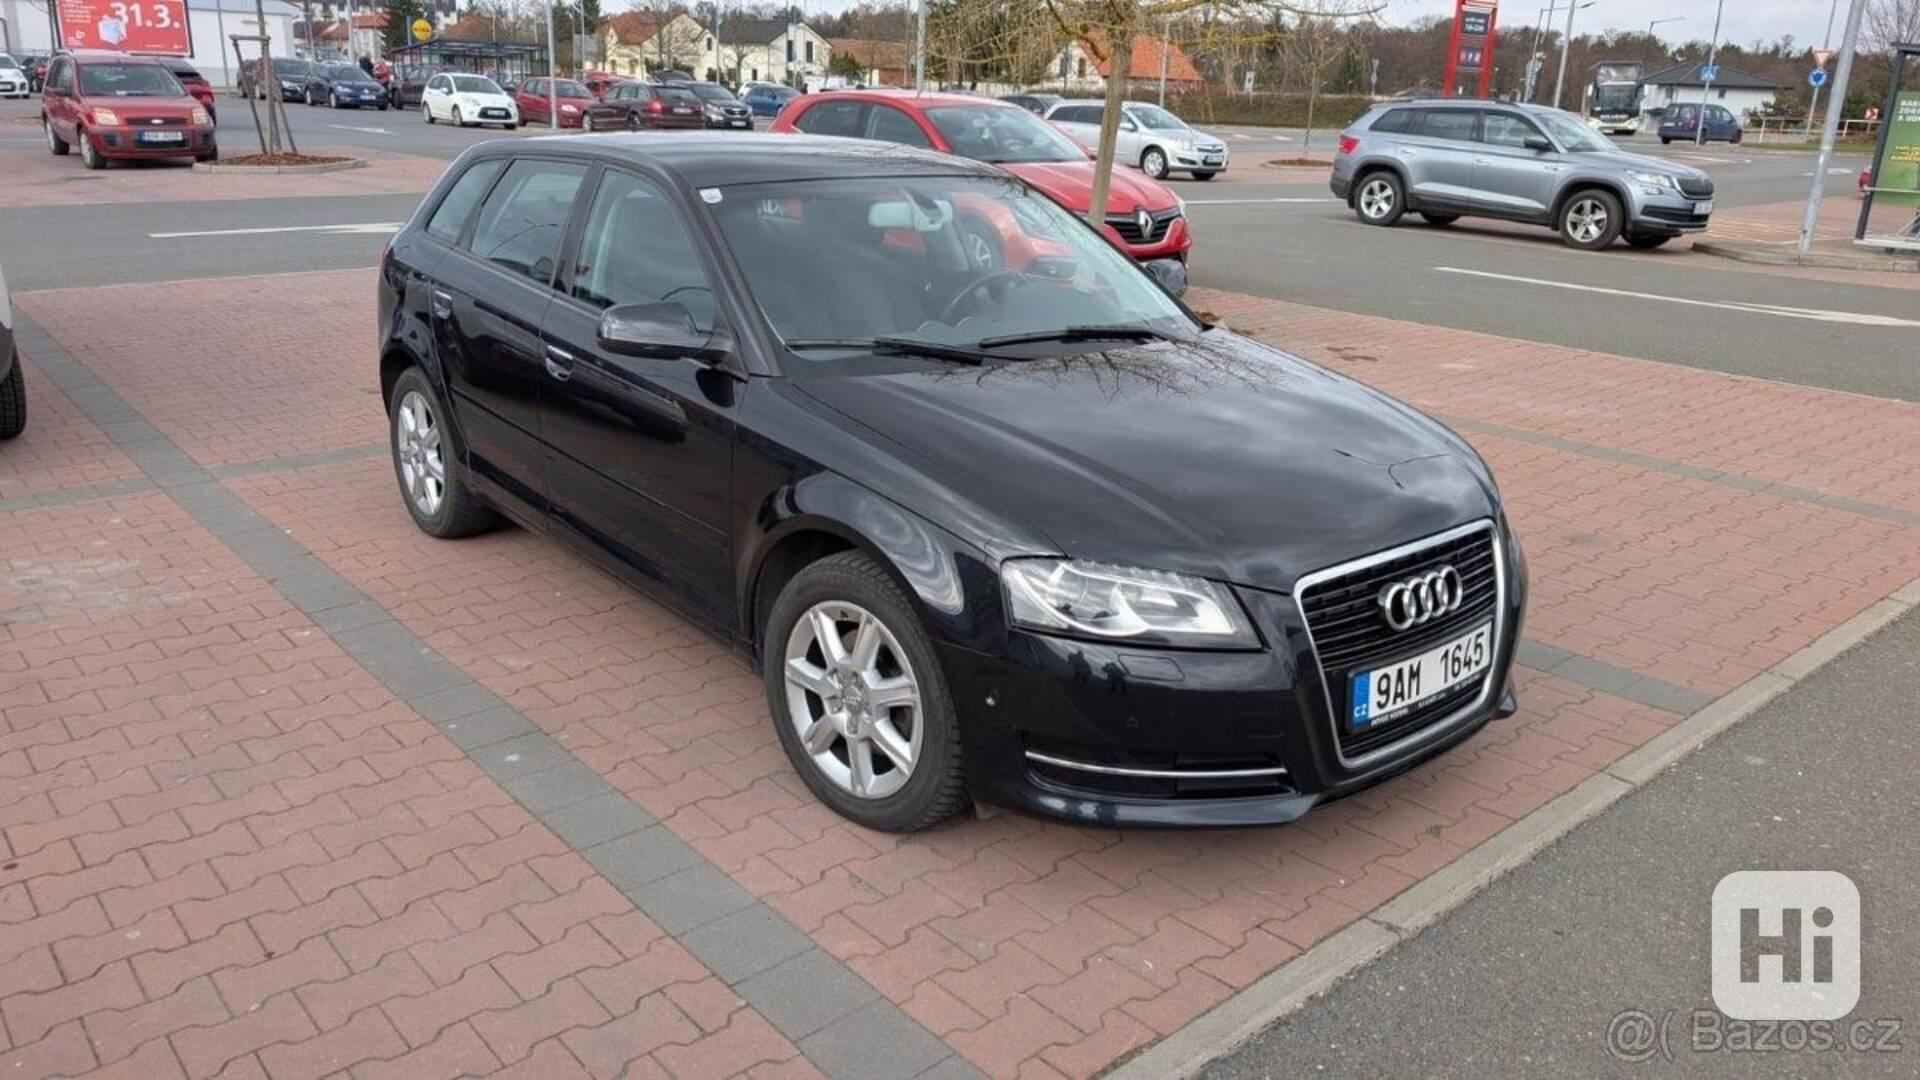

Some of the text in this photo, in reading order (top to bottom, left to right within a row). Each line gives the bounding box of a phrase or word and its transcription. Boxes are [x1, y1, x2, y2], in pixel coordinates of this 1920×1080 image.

[110, 2, 180, 29] 31.3.
[1377, 632, 1485, 709] 9AM 1645
[1354, 705, 1367, 718] CZ
